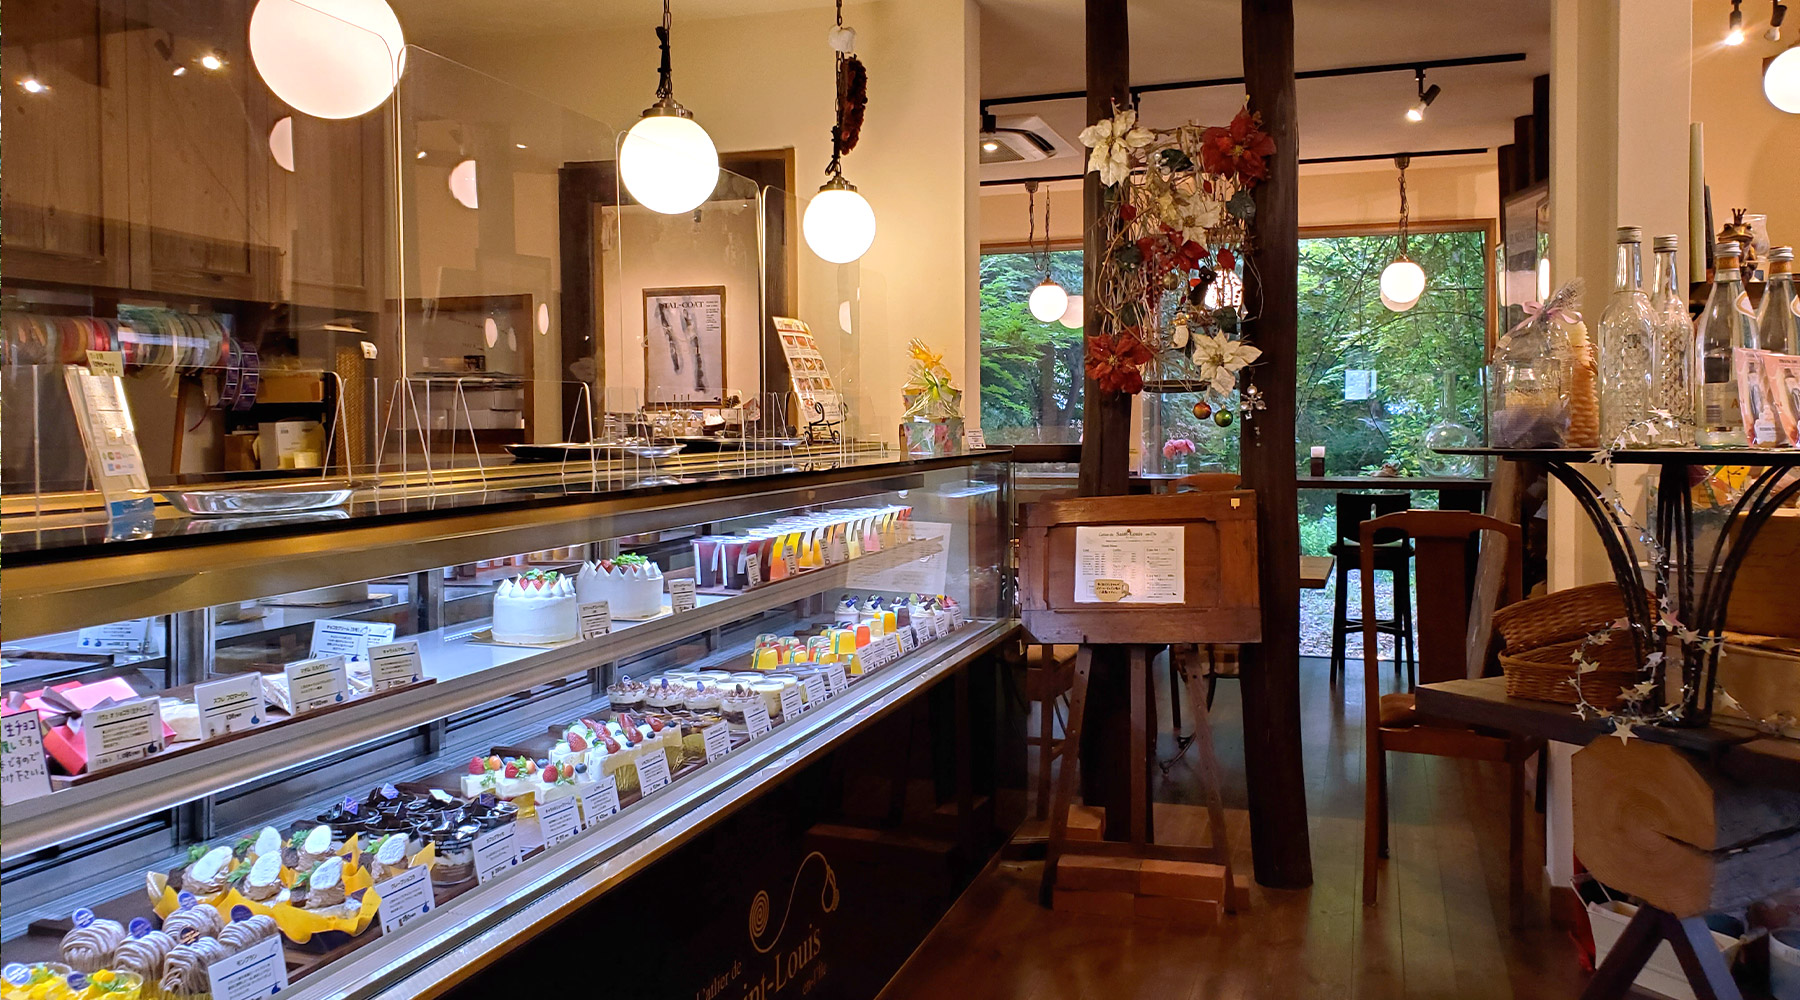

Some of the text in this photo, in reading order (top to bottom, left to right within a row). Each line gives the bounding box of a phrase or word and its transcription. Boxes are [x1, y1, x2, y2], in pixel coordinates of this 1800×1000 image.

[4, 719, 36, 738] 生チョコ
[236, 953, 258, 967] モンブラン
[731, 960, 743, 980] de
